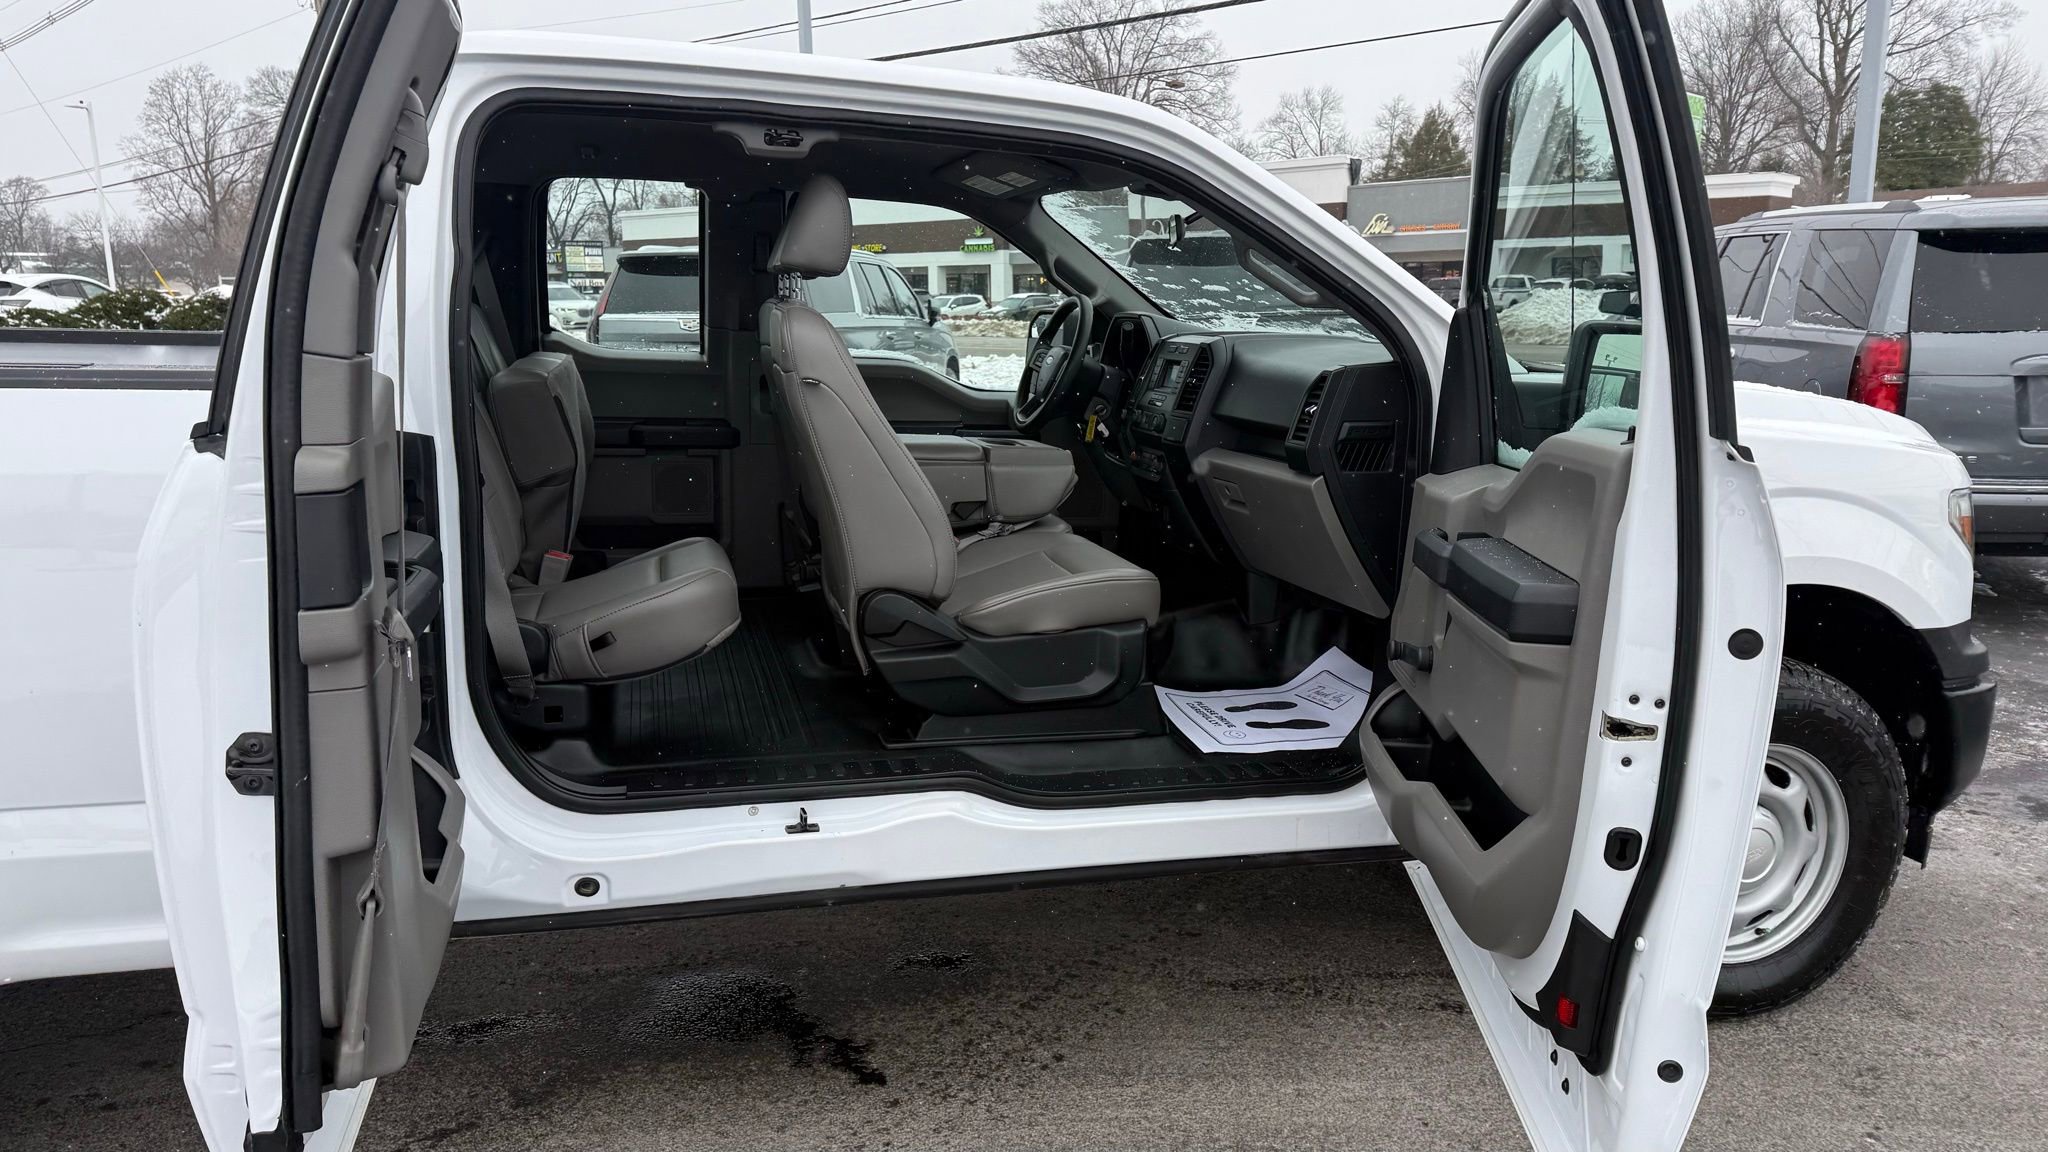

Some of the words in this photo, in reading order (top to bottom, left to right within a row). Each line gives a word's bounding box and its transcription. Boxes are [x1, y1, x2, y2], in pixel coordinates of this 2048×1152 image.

[864, 243, 882, 252] STORE
[960, 244, 995, 252] CANNABIS
[1186, 702, 1222, 727] CAREFULLY!
[1194, 701, 1219, 716] PLEASE
[1214, 715, 1236, 728] DRIVE
